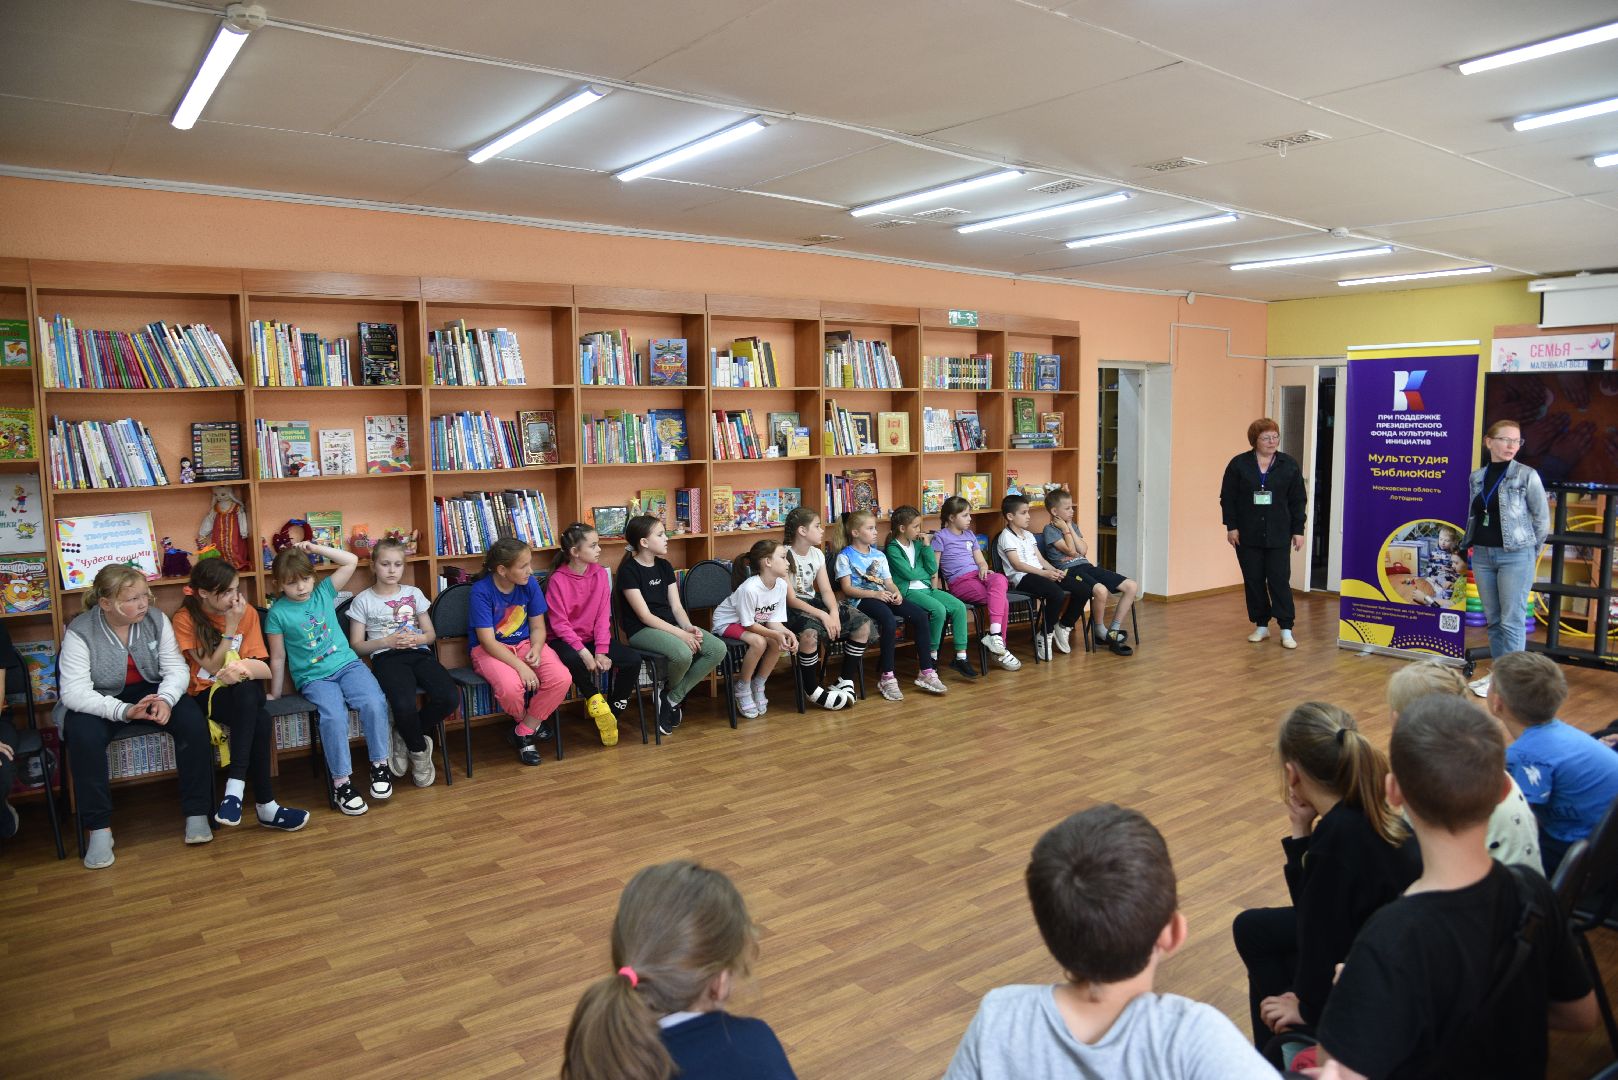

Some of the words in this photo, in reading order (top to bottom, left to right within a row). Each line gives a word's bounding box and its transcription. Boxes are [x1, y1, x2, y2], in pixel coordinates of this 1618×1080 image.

[1530, 342, 1571, 358] СЕМЬЯ
[1530, 360, 1568, 370] МАЛЕНЬКАЯ
[1394, 414, 1441, 422] ПОДДЕРЖКЕ
[1376, 422, 1442, 430] ПРЕЗИДЕНТСКОГО
[1398, 430, 1448, 438] КУЛЬТУРНЫХ
[1385, 438, 1432, 446] ИНИЦИАТИВ
[1368, 453, 1448, 465] Мультстудия
[1370, 467, 1446, 479] "БиблиоKids"
[1389, 494, 1423, 502] Лотошино
[92, 519, 131, 529] Работы
[84, 527, 143, 541] творческой
[86, 537, 145, 551] мастерской
[76, 553, 113, 569] "Чудеса
